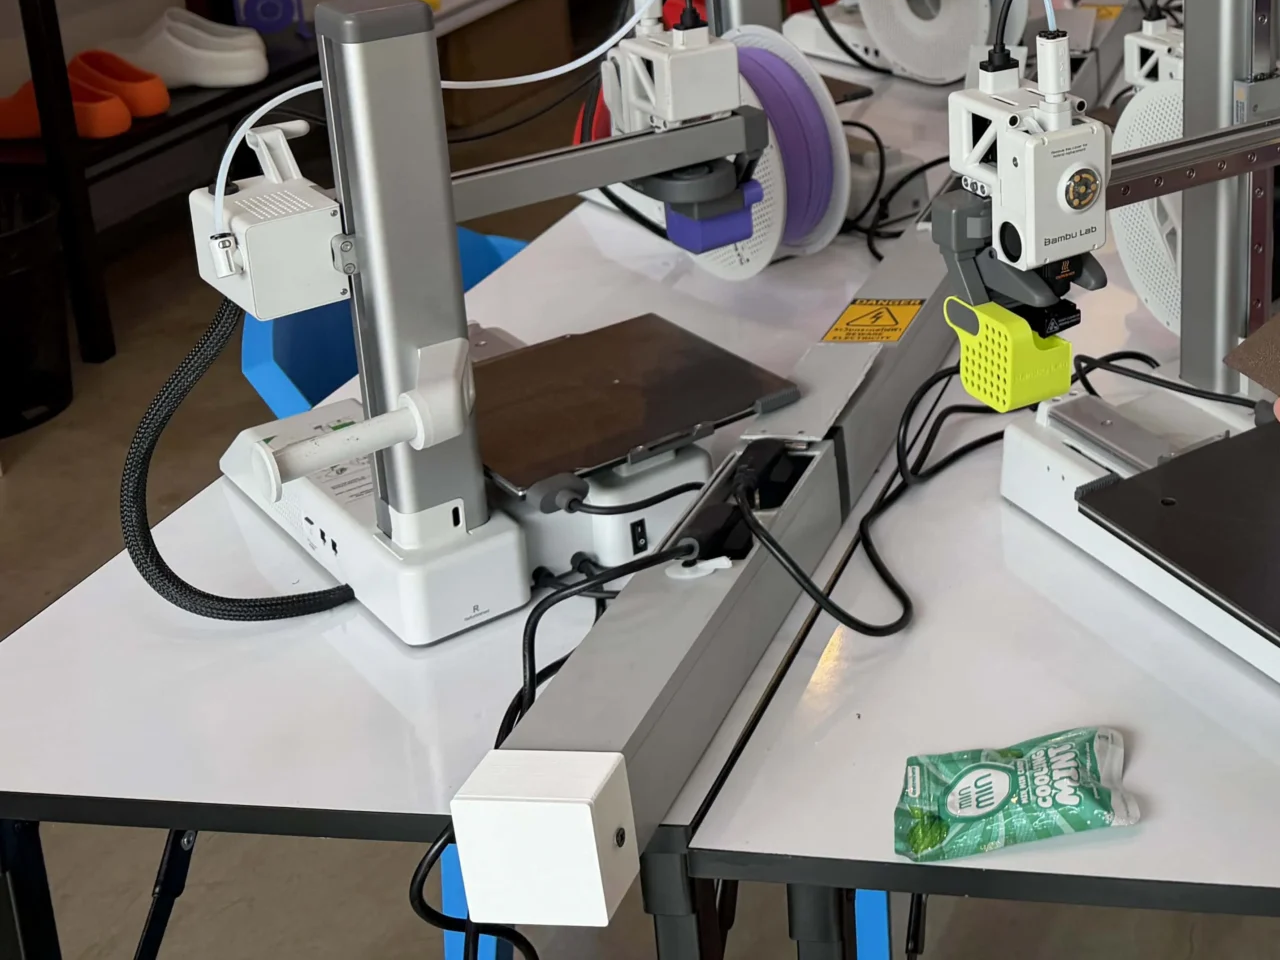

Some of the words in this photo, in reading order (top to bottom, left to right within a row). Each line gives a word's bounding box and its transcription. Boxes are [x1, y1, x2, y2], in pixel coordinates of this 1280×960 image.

[1044, 231, 1078, 247] Bambu
[1079, 225, 1097, 237] Lab
[974, 772, 995, 810] min
[1031, 749, 1053, 808] COOLING
[1047, 744, 1080, 806] MINT
[958, 785, 972, 810] min
